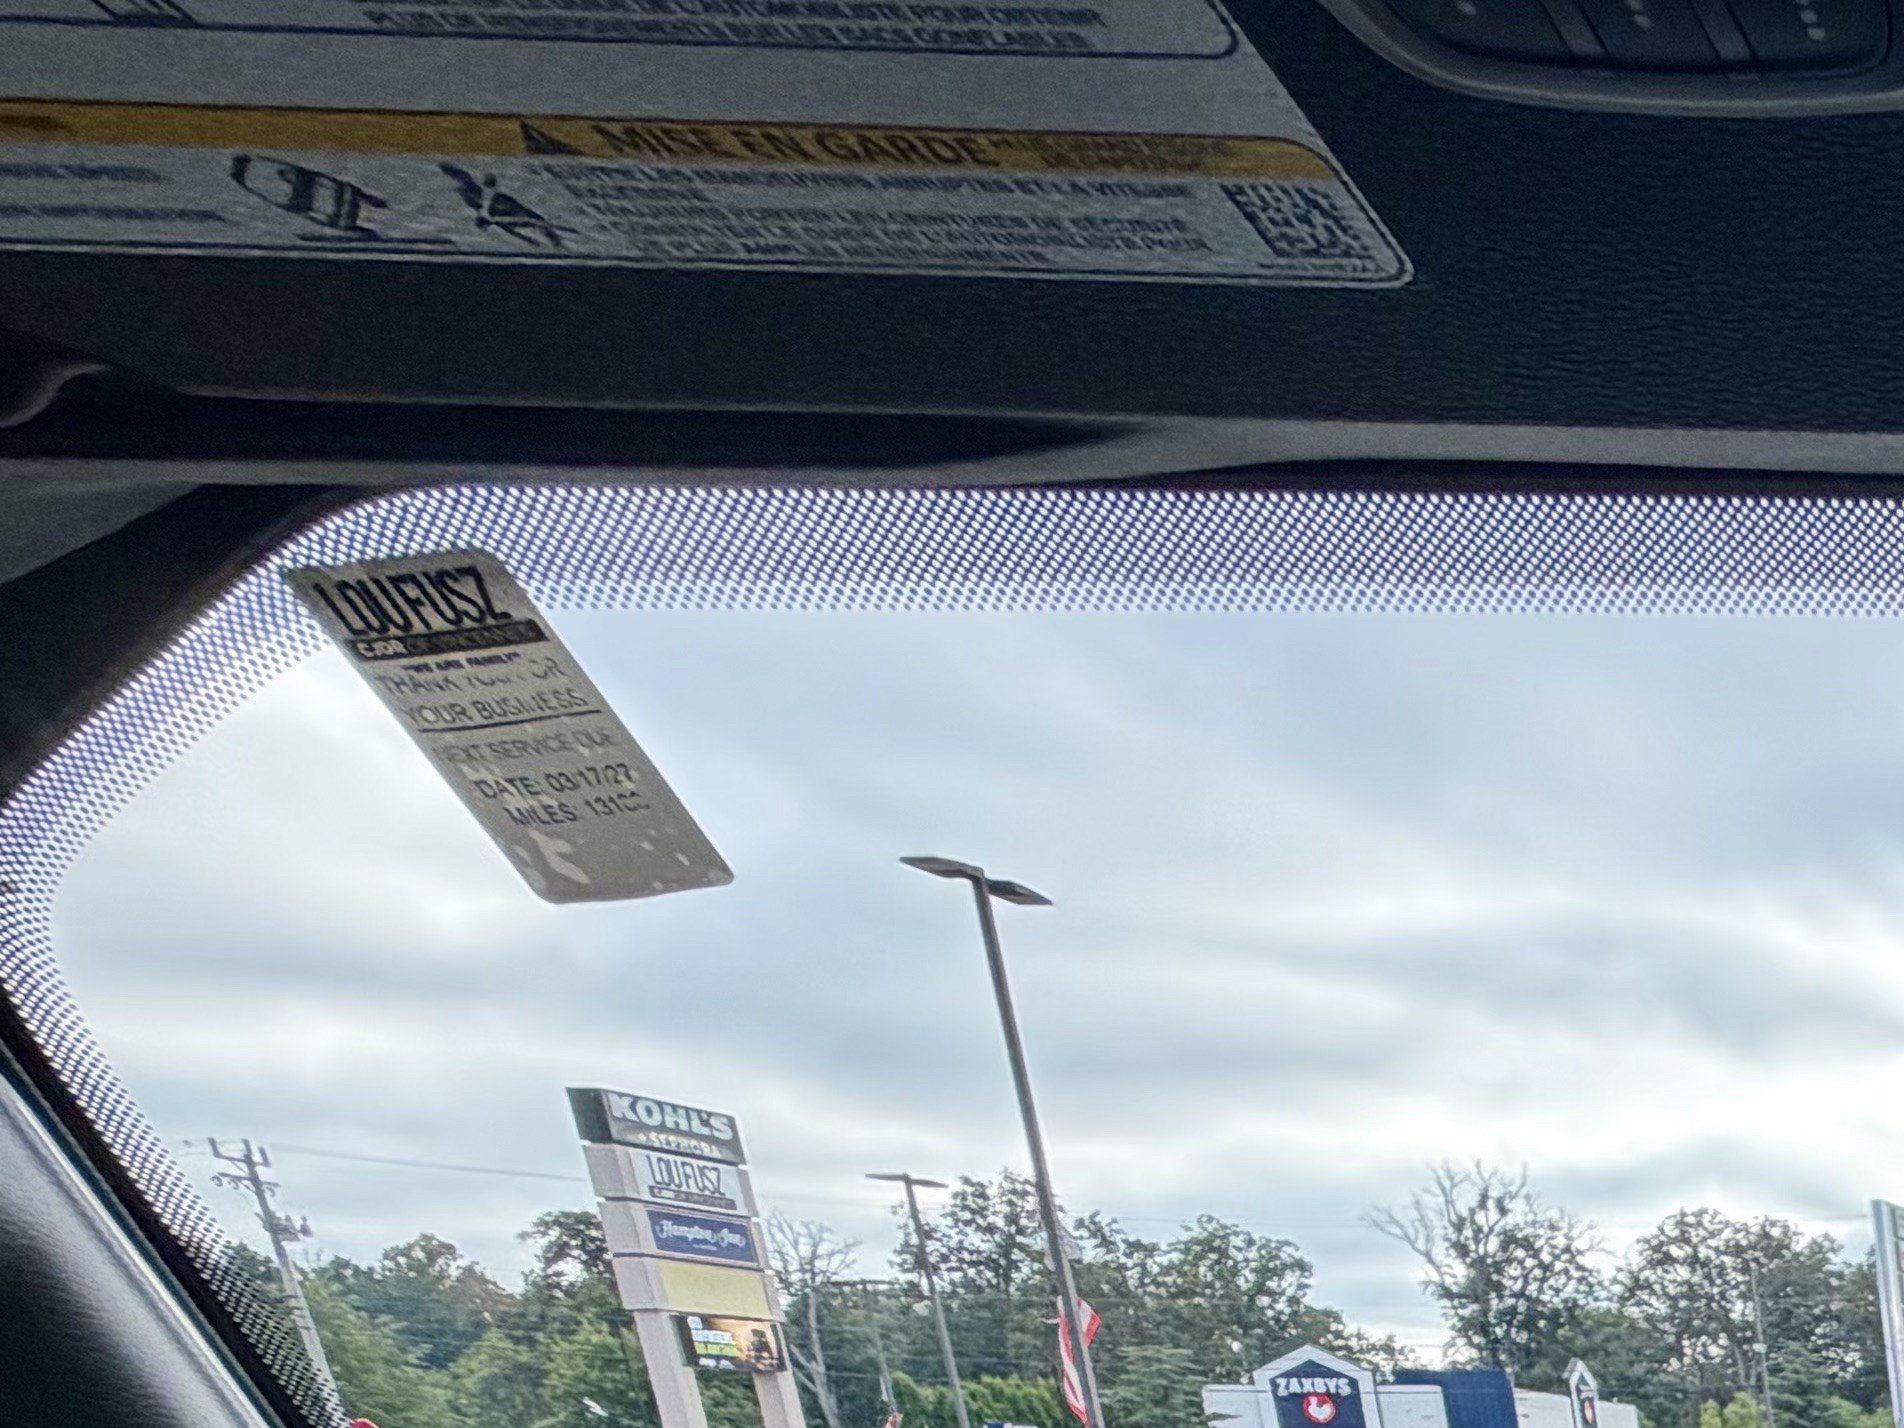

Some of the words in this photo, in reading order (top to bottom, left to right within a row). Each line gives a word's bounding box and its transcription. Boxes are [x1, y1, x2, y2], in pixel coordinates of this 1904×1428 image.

[596, 121, 727, 160] MISE
[738, 129, 806, 163] EN
[812, 130, 996, 170] GARDE
[606, 1091, 735, 1141] KOHL'S
[1275, 1377, 1352, 1398] ZAXBYS
